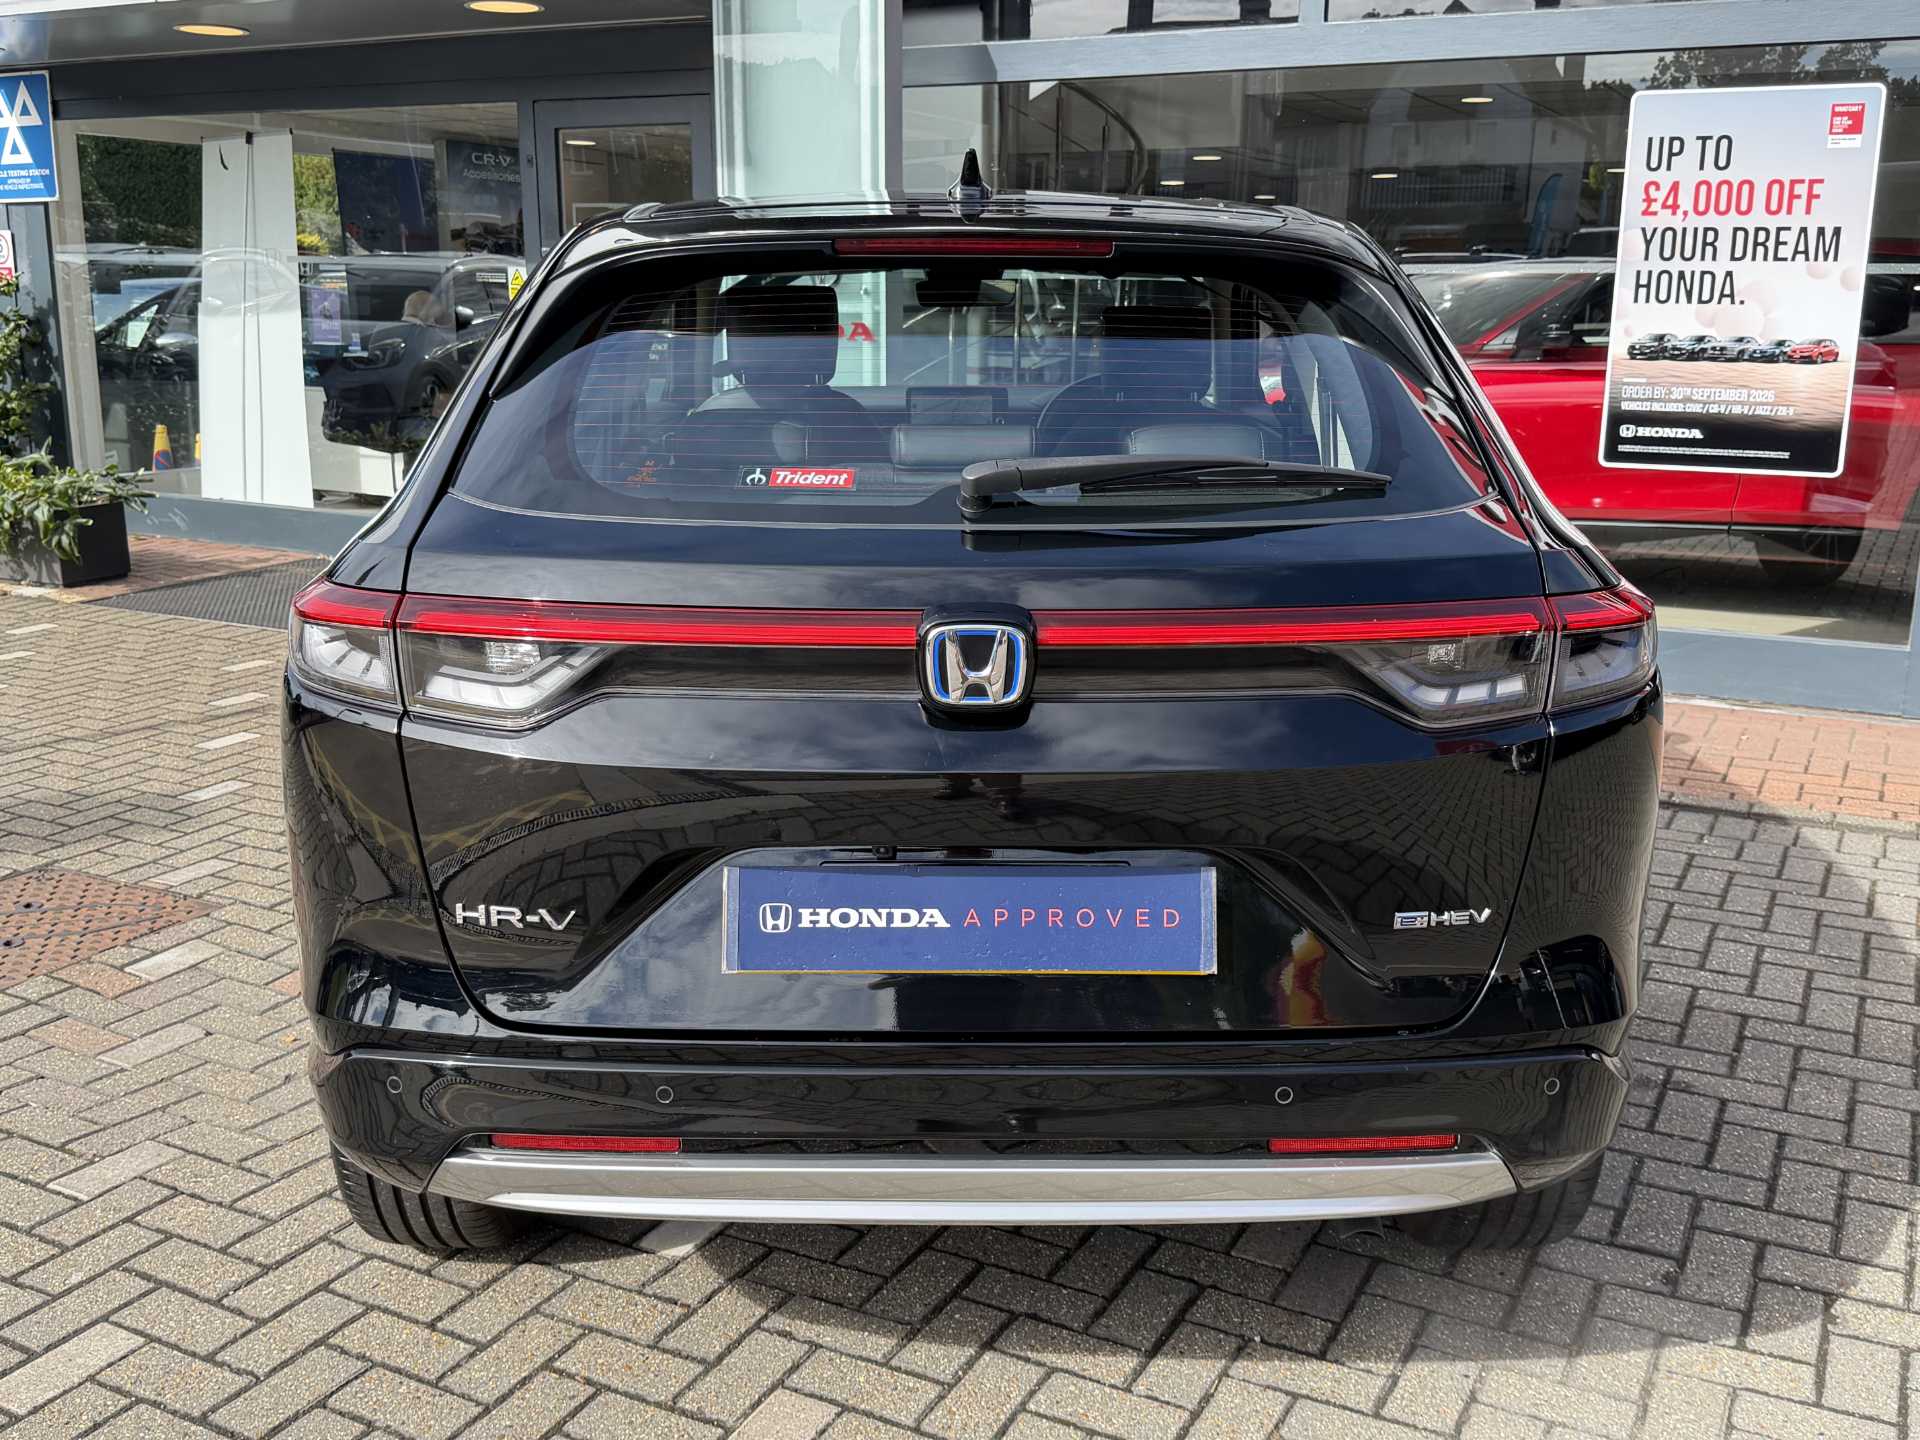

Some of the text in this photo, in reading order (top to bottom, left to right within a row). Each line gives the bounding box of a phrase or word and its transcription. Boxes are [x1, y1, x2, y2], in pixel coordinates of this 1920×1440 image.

[1645, 135, 1733, 171] UP TO
[1640, 178, 1825, 222] £4,000 OFF
[1640, 226, 1842, 262] YOUR DREAM
[1632, 269, 1745, 305] HONDA.
[1622, 385, 1652, 398] ORDER
[1653, 386, 1669, 399] BY:
[1691, 387, 1748, 402] SEPTEMBER
[1749, 389, 1776, 402] 2026
[1636, 427, 1704, 439] HONDA
[775, 471, 849, 485] Trident
[455, 902, 577, 931] HR-V
[798, 907, 951, 928] HONDA
[963, 908, 1181, 928] APPROVED
